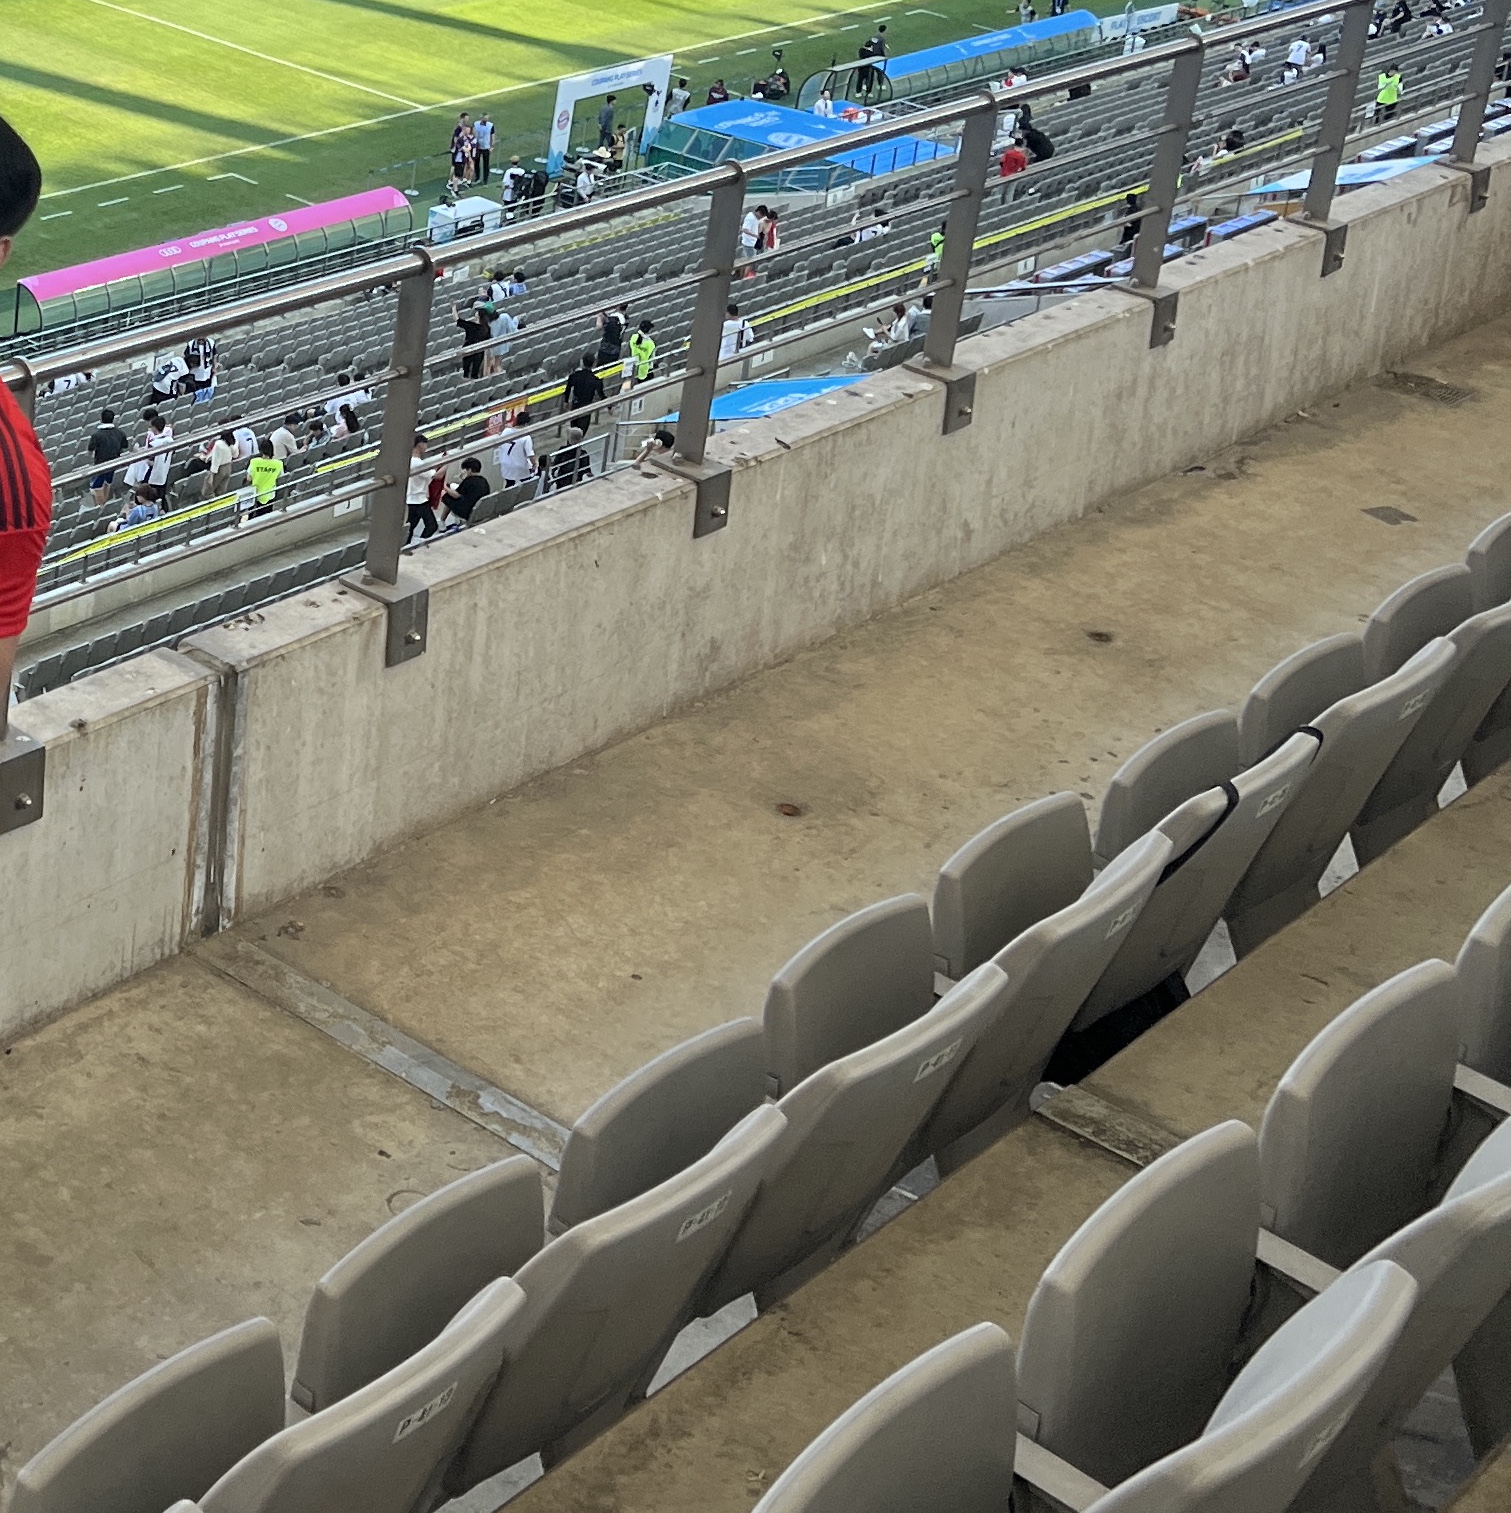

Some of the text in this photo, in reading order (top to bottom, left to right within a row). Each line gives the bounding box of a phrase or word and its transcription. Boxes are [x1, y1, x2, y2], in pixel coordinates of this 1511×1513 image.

[591, 69, 643, 87] COUPANG PLAY SERIES
[189, 226, 259, 248] COUPANG PLAY SERIES
[63, 379, 71, 389] 7
[507, 442, 516, 456] 7
